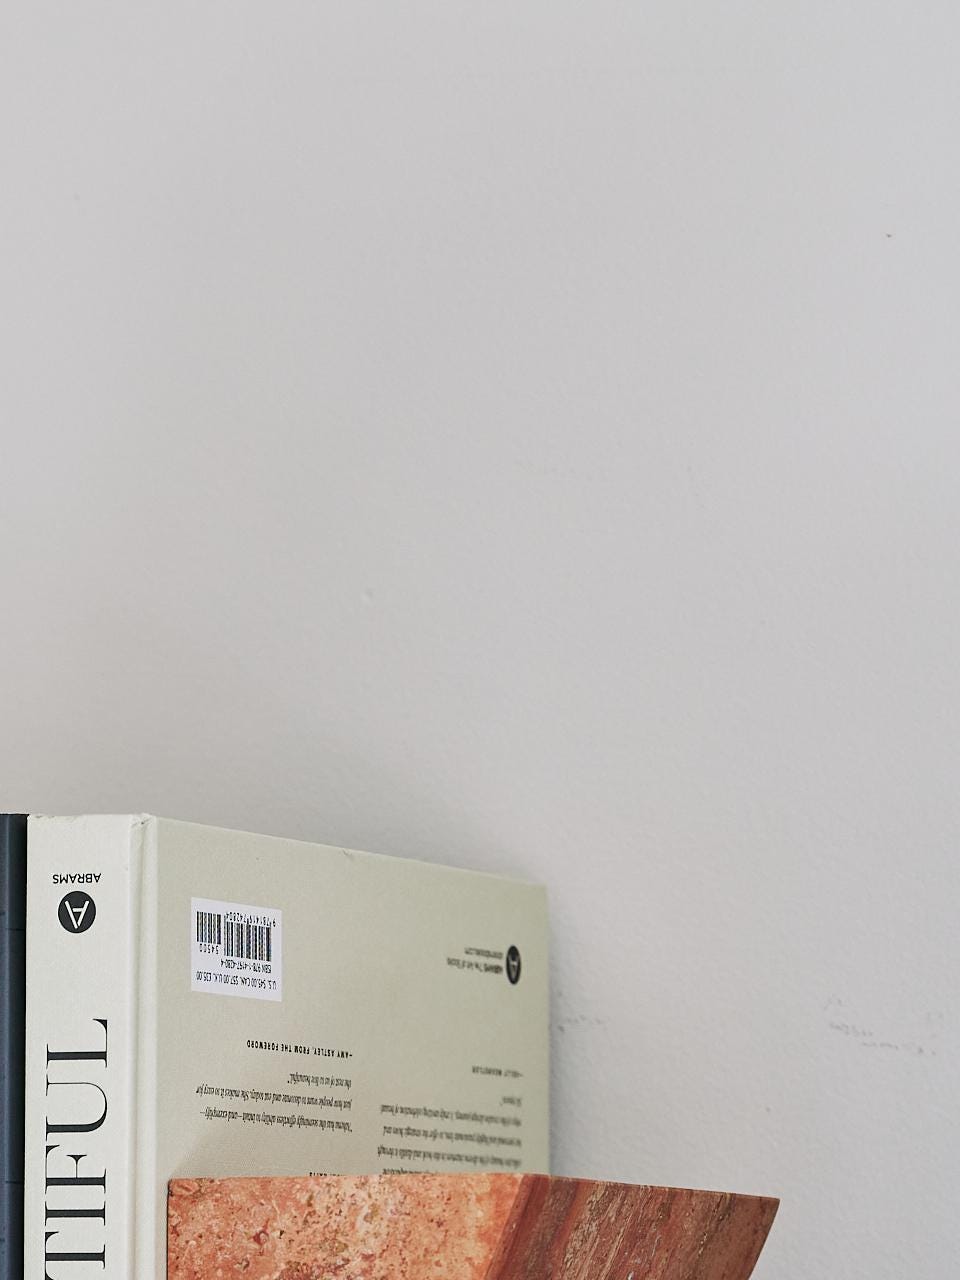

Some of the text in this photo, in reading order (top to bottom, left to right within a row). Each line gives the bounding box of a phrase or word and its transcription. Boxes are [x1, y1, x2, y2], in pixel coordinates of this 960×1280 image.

[52, 873, 102, 884] ABRAMS
[246, 1039, 279, 1051] FOREWORD
[281, 1044, 292, 1053] THE
[294, 1046, 310, 1055] FROM
